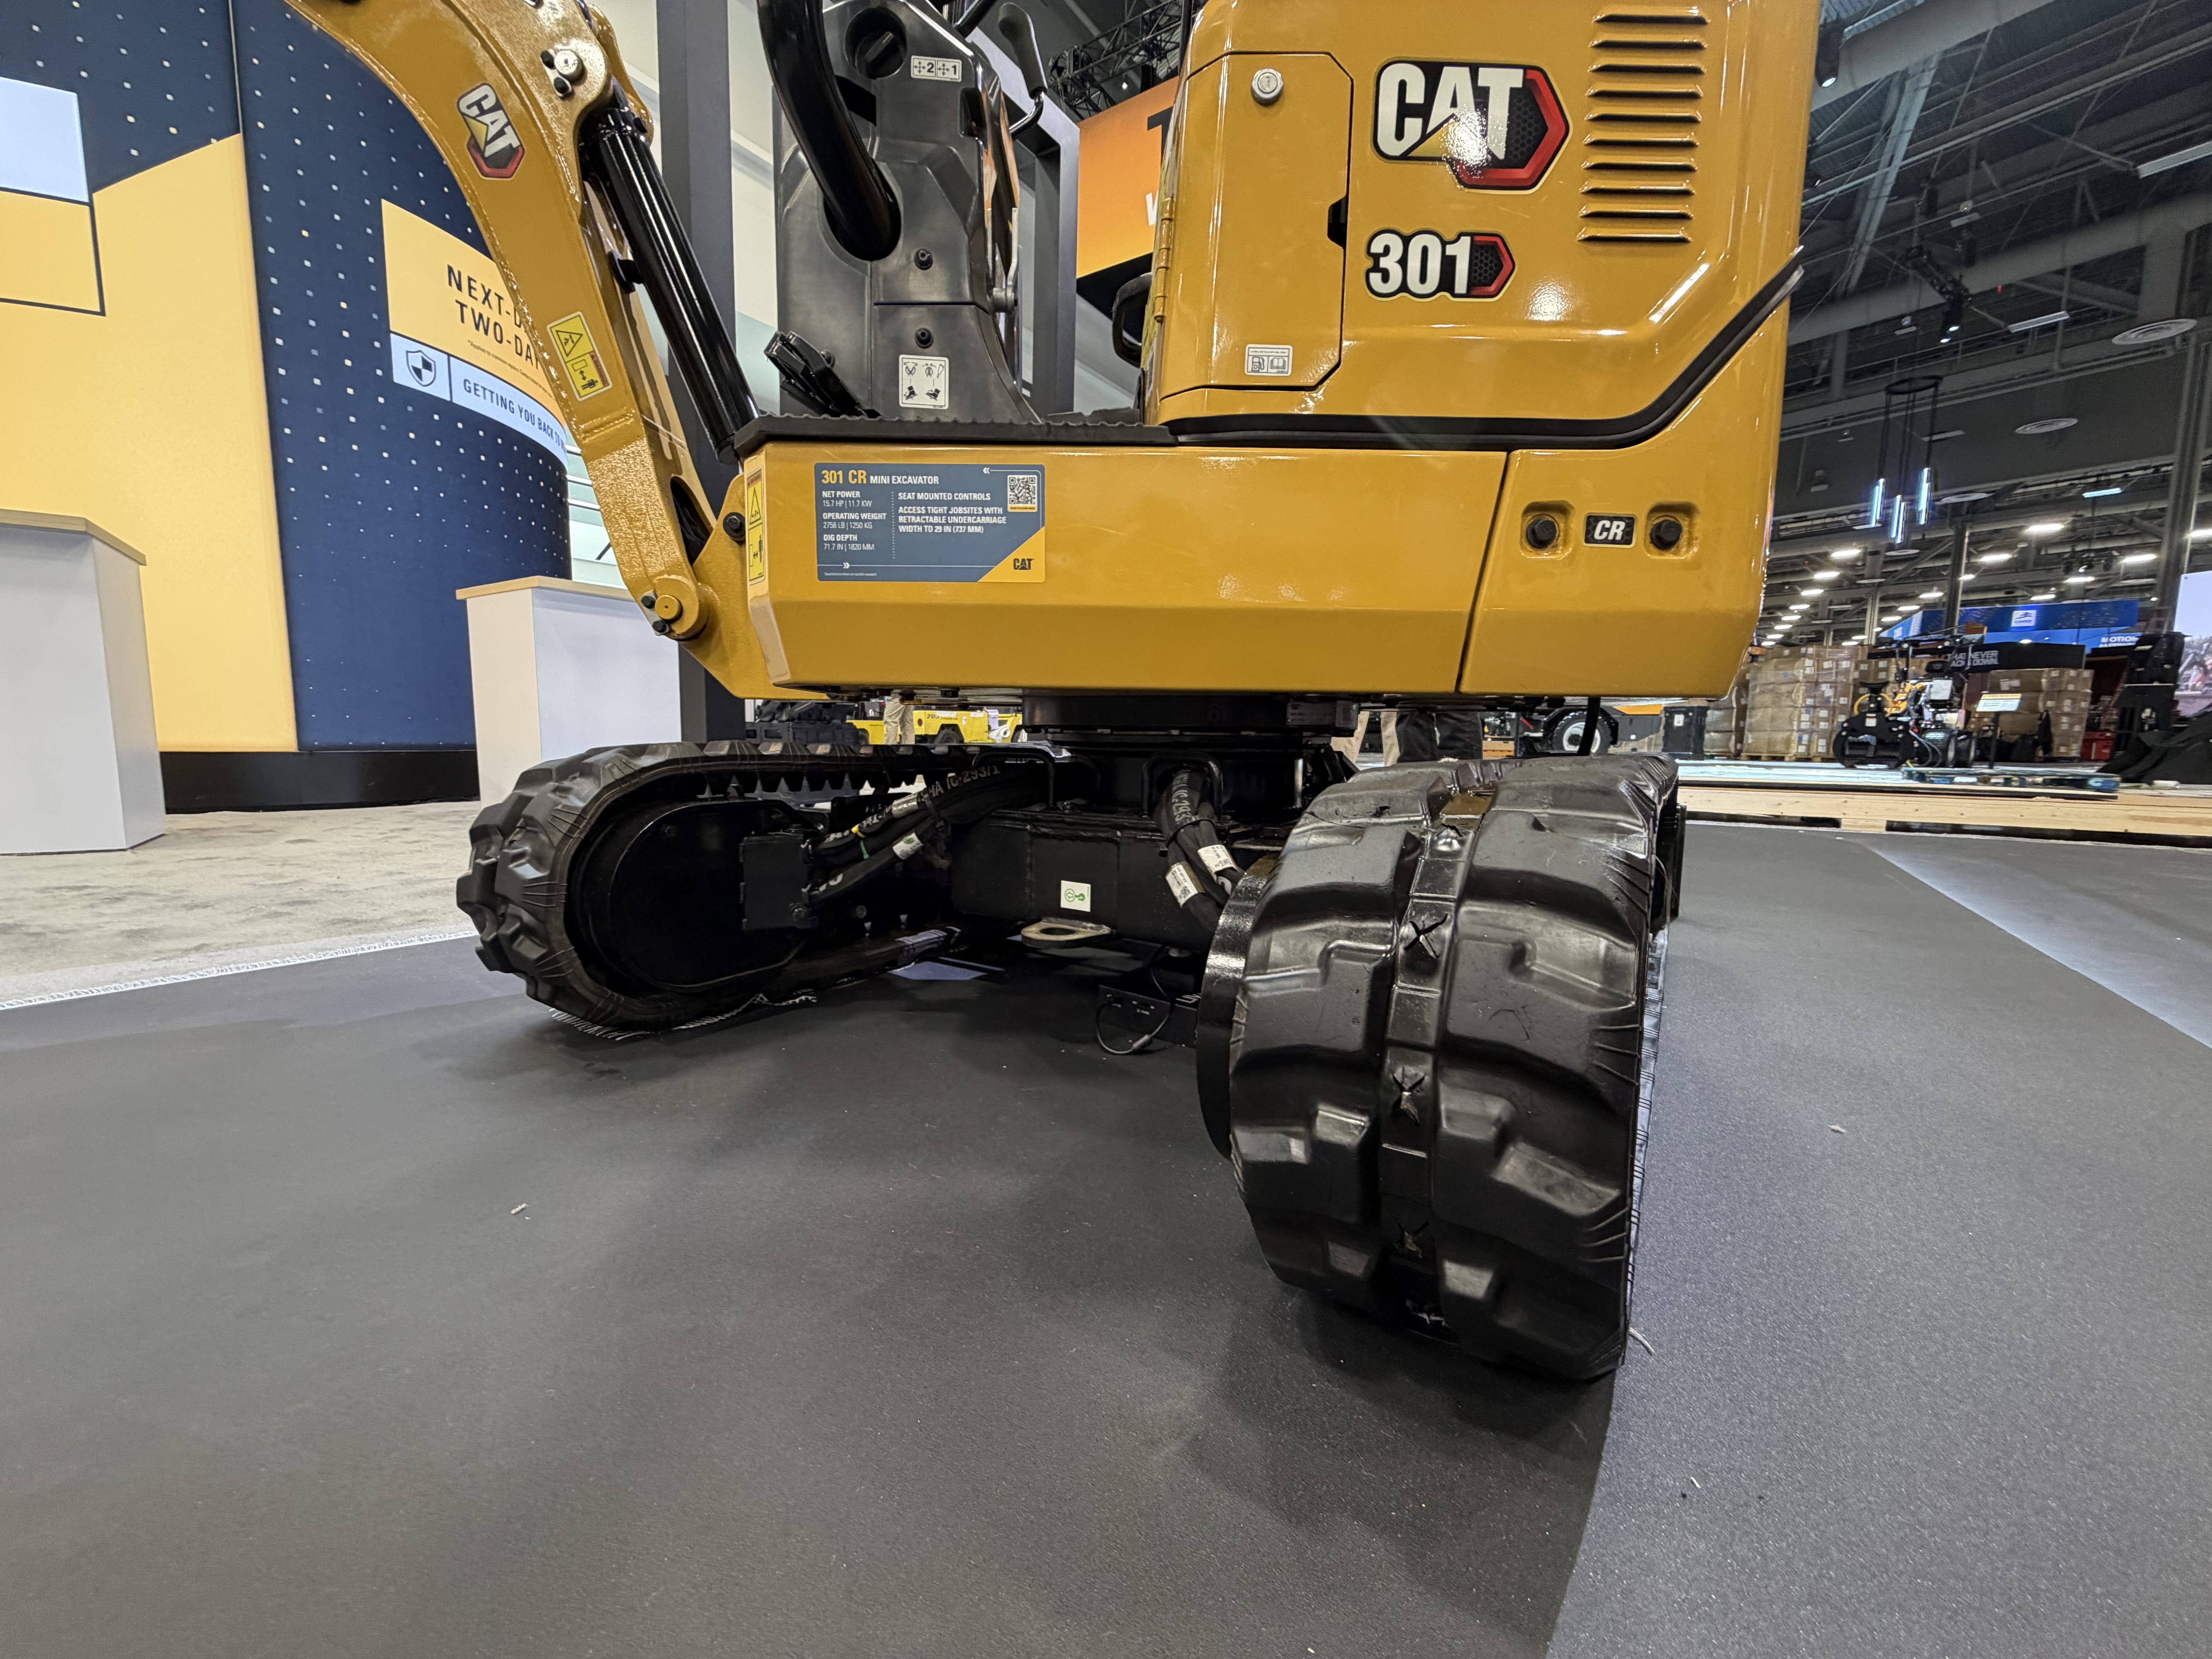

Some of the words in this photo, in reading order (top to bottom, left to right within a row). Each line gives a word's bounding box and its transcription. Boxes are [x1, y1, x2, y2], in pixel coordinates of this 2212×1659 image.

[927, 62, 934, 73] 2
[951, 65, 957, 75] 1
[459, 85, 520, 158] CAT
[1377, 63, 1524, 160] CAT
[1369, 233, 1471, 294] 301
[463, 378, 515, 414] GETTING
[518, 405, 535, 426] YOU
[538, 417, 554, 441] BACK
[555, 431, 560, 447] TO
[821, 470, 843, 484] 301
[848, 470, 867, 484] CR
[870, 476, 890, 484] MINI
[891, 476, 939, 484] EXCAVATOR
[1594, 520, 1626, 541] CR
[1013, 558, 1035, 570] CAT
